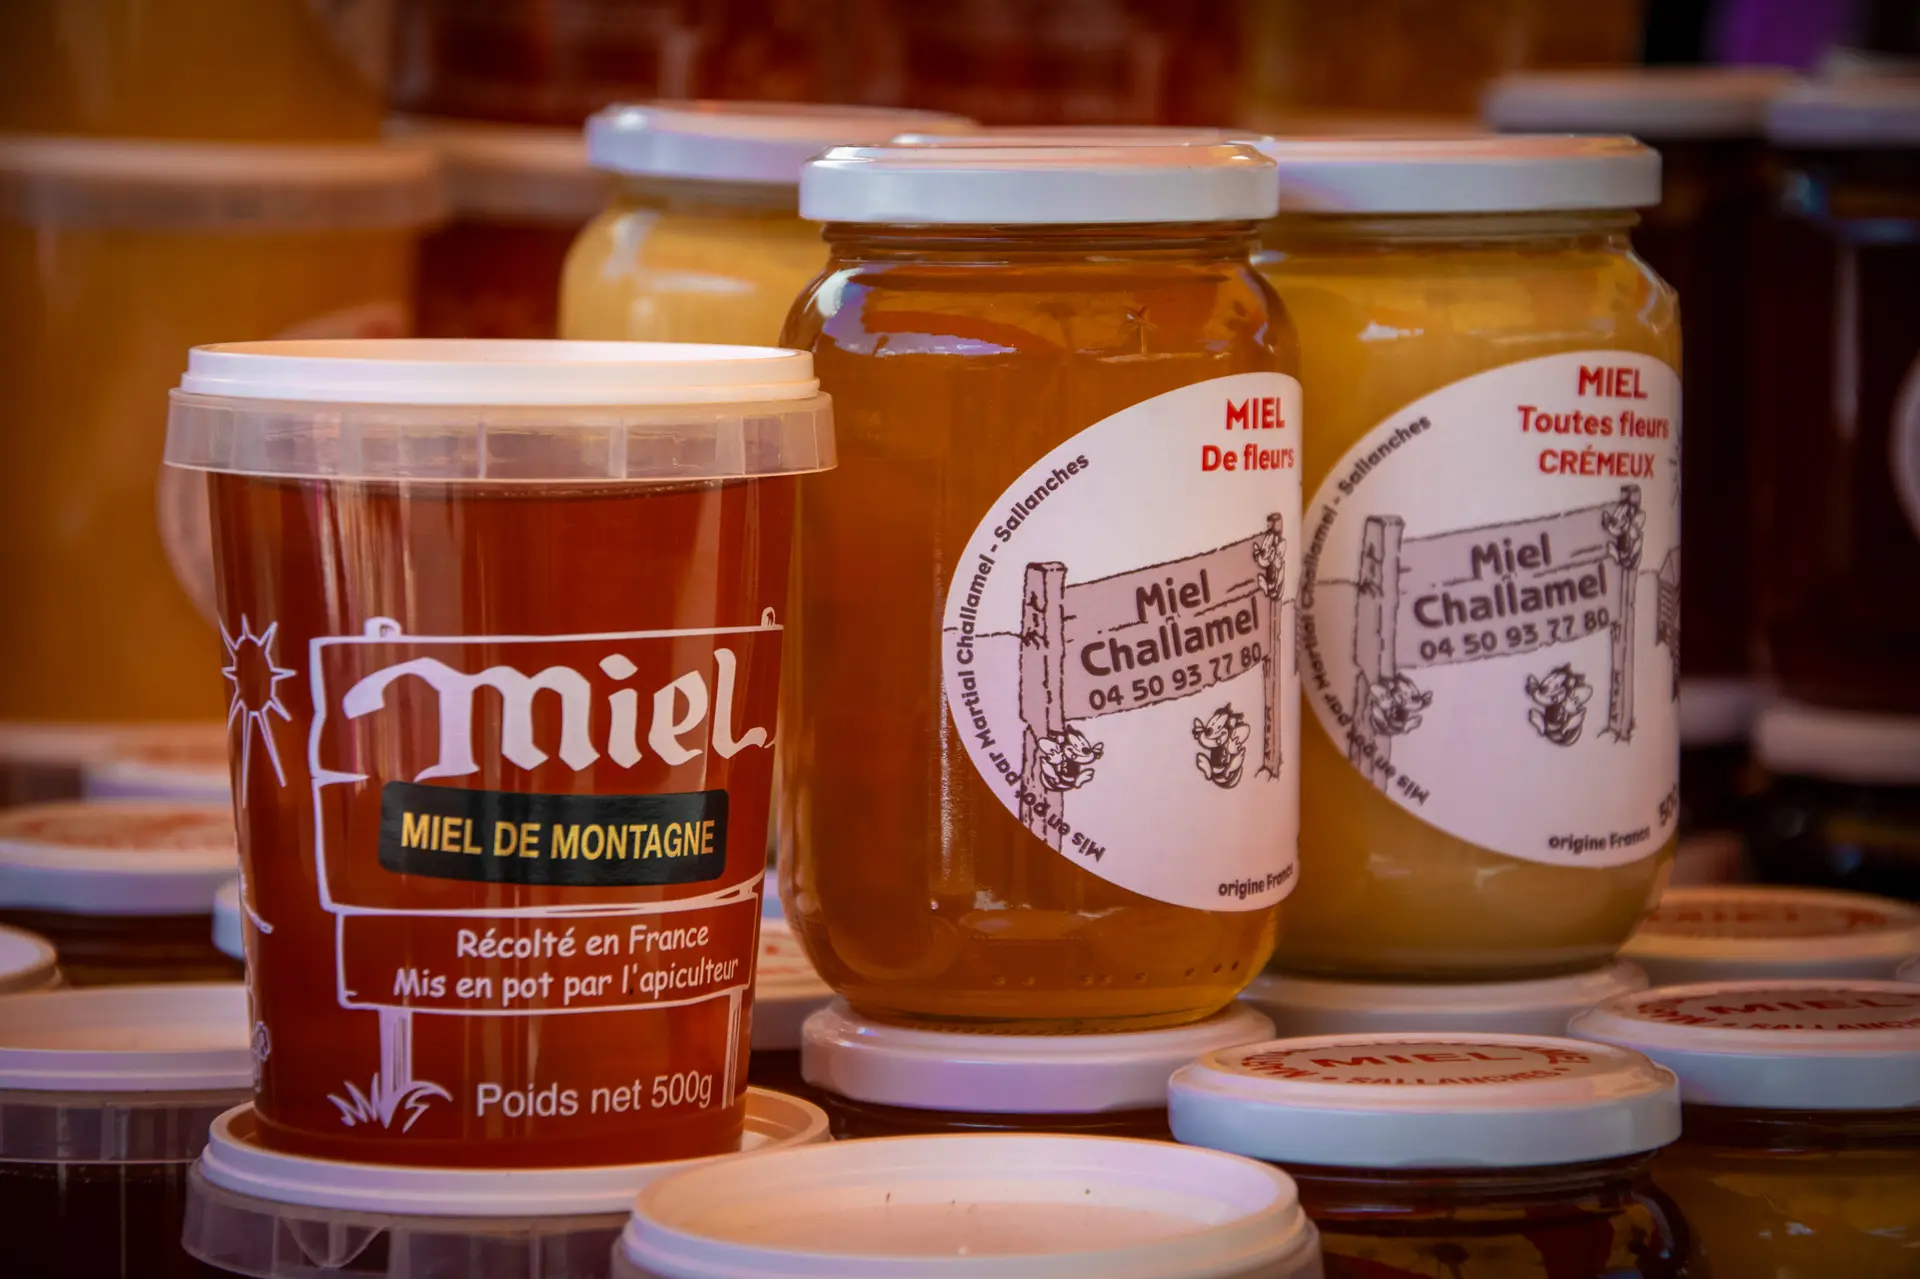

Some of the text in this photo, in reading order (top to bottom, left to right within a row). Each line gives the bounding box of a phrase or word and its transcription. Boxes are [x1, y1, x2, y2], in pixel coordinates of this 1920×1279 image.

[1577, 365, 1648, 399] MIEL
[1225, 397, 1286, 430] MIEL
[1517, 405, 1670, 440] Toutes fleurs
[1201, 443, 1295, 472] De fleurs
[1337, 414, 1432, 497] Sallanches
[1538, 445, 1656, 478] CRÉMEUX
[994, 453, 1090, 543] Sallanches
[1470, 531, 1552, 580] Miel
[956, 553, 996, 665] Challamel
[1135, 568, 1211, 623] Miel
[1413, 561, 1608, 628] Challamel
[1080, 595, 1260, 677] Challamel
[1419, 607, 1610, 661] 04 50 93 77 80
[1089, 642, 1262, 711] 04 50 93 77 80
[957, 670, 996, 750] Martial
[988, 751, 1023, 787] par
[1014, 784, 1051, 818] pot
[400, 810, 715, 861] MIEL DE MONTAGNE
[1047, 813, 1071, 836] en
[1071, 831, 1107, 863] Mis
[1548, 833, 1606, 856] origine
[1218, 877, 1265, 901] origine
[456, 923, 710, 959] Récolté en France
[393, 968, 447, 998] Mis
[455, 973, 492, 999] en
[501, 969, 555, 1008] pot
[563, 972, 613, 1006] par
[621, 954, 739, 999] l'apiculteur
[1704, 999, 1913, 1015] MIEL
[1309, 1051, 1523, 1068] MIEL
[476, 1073, 713, 1118] Poids net 500g
